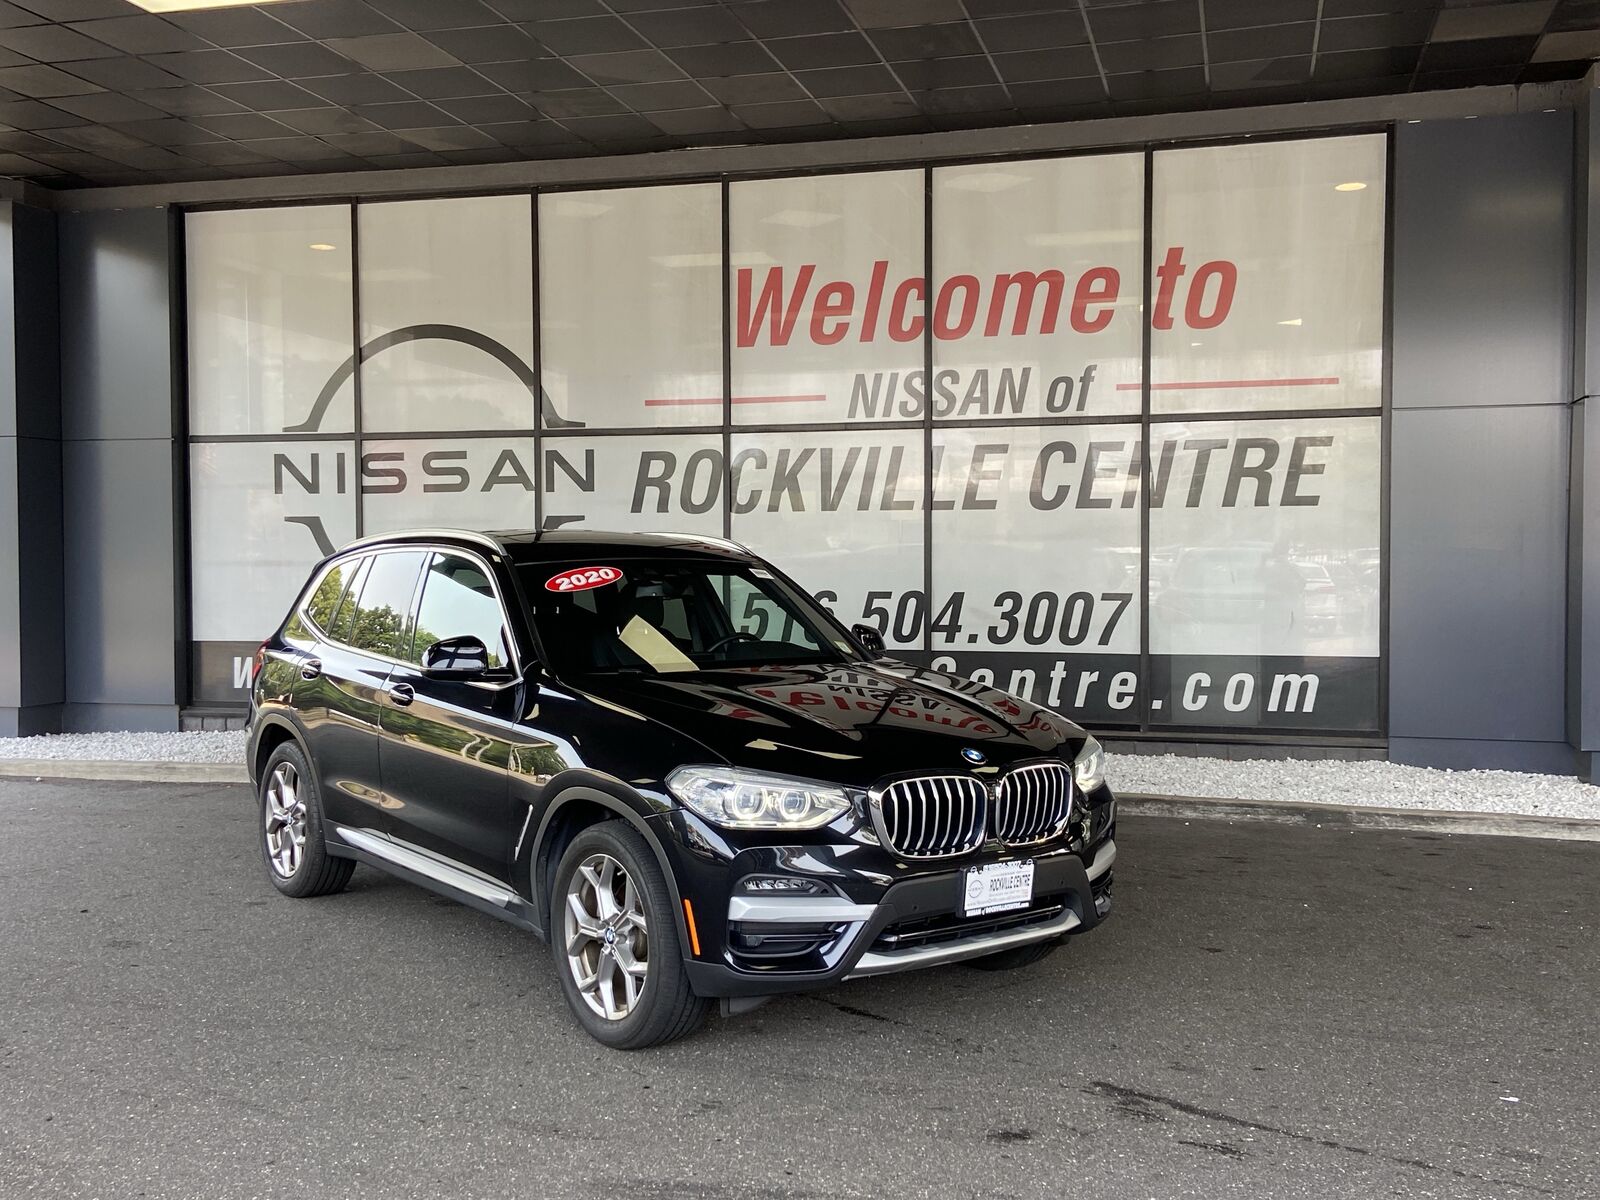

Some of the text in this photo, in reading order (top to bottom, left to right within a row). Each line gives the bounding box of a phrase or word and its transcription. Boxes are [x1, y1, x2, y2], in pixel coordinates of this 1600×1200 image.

[737, 246, 1237, 347] Welcome to
[847, 364, 1097, 418] NISSAN of
[274, 449, 595, 494] NISSAN
[630, 435, 1334, 515] ROCKVILLE CENTRE
[555, 568, 615, 591] 2020
